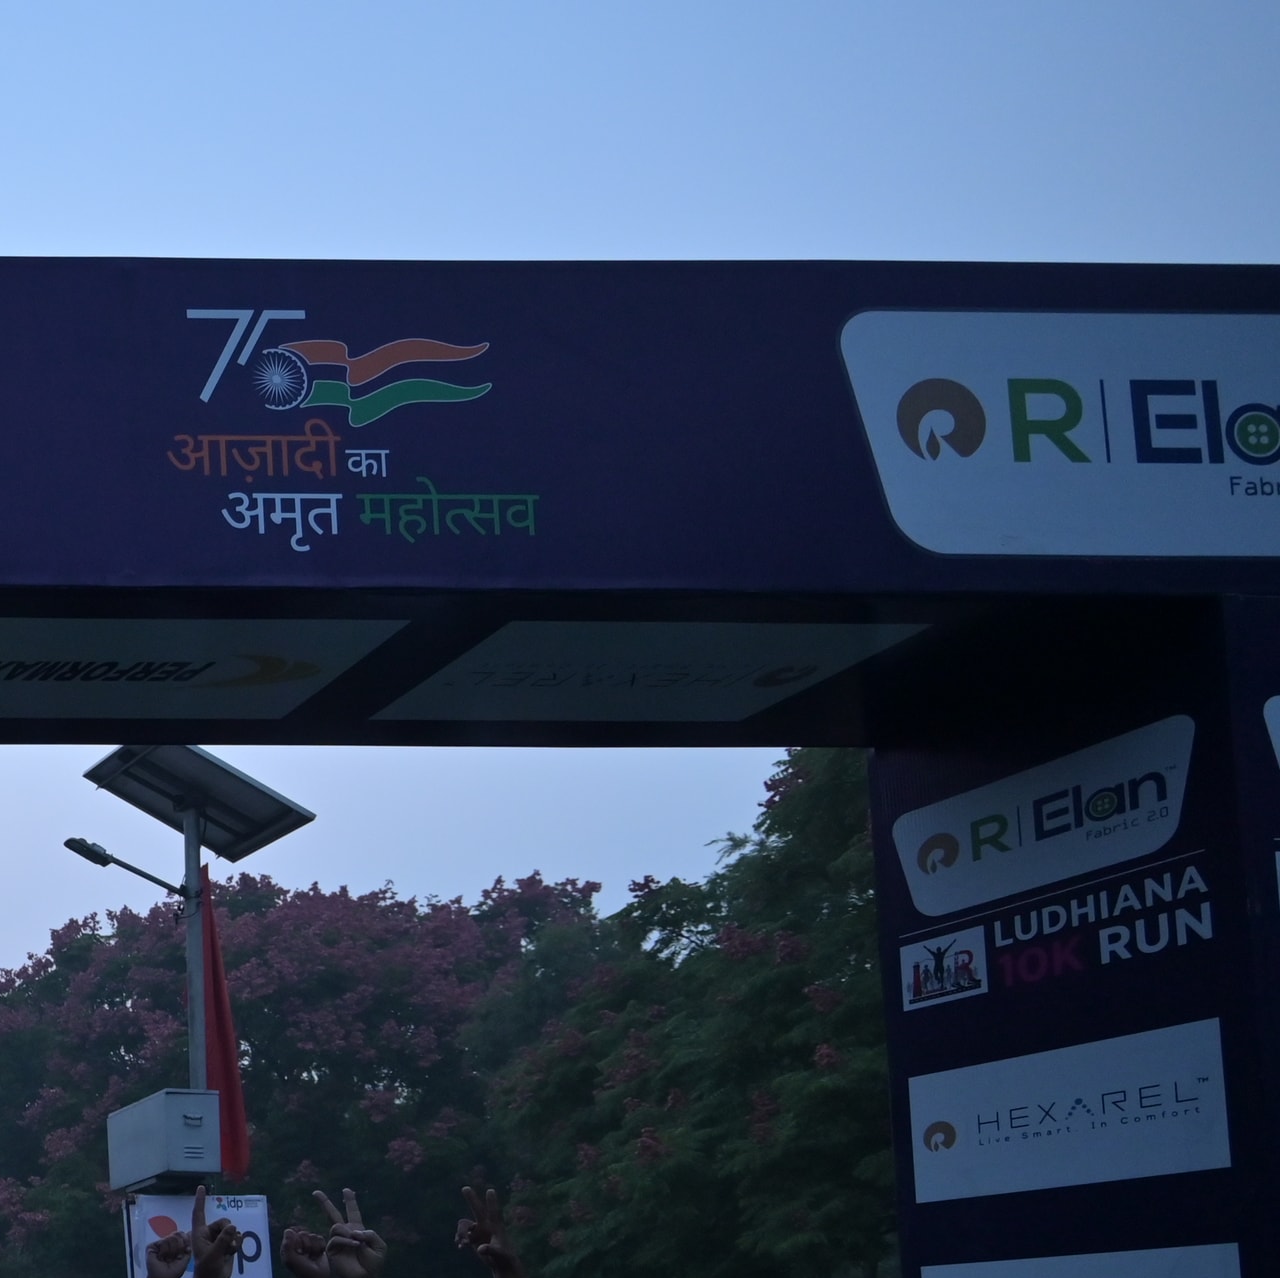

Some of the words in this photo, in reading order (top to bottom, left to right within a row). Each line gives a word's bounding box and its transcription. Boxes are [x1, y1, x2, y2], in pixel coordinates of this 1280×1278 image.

[167, 418, 341, 483] आज़ादी
[345, 449, 389, 477] का
[1007, 378, 1092, 463] R
[221, 491, 343, 552] अमृत
[356, 476, 540, 543] महोत्सव
[1230, 476, 1280, 496] Fab
[970, 814, 1013, 862] R
[1033, 772, 1167, 842] Elan
[1086, 817, 1139, 841] Fabric
[1147, 806, 1169, 822] 2.0
[994, 865, 1208, 948] LUDHIANA
[998, 937, 1085, 987] 10K
[1099, 902, 1214, 965] RUN
[979, 1135, 1011, 1146] Live
[1091, 1121, 1107, 1129] In
[1120, 1107, 1200, 1124] Comfort
[227, 1197, 243, 1211] idp
